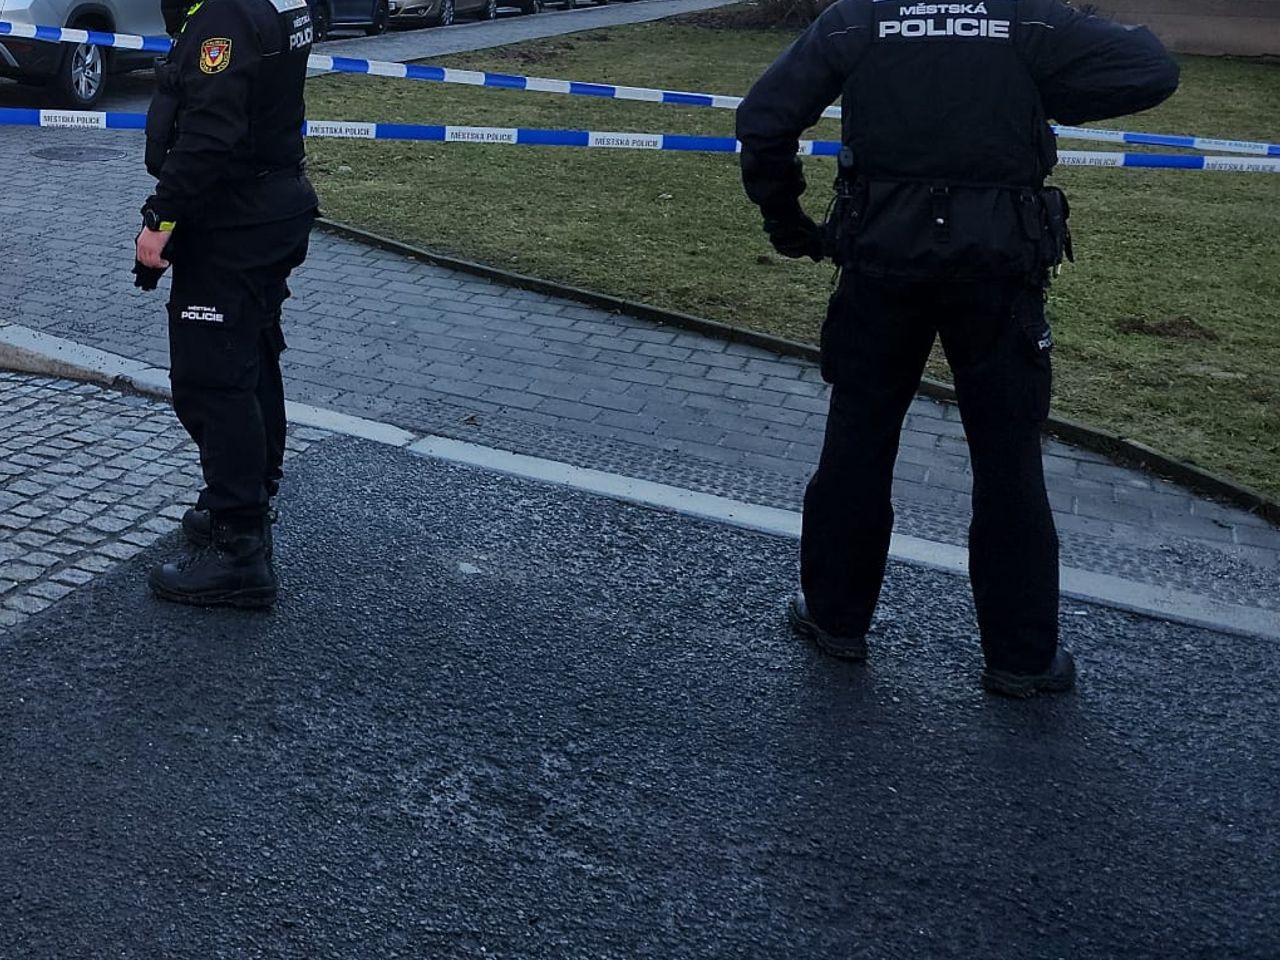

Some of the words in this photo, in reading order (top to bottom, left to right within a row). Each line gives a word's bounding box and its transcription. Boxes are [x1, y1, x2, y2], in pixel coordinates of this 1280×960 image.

[900, 2, 988, 16] MĚSTSKÁ
[879, 18, 1010, 38] POLICIE
[310, 125, 343, 135] MĚSTSKÁ
[594, 136, 630, 146] MĚSTSKÁ
[631, 139, 658, 147] POLICIE
[181, 311, 224, 323] POLICIE
